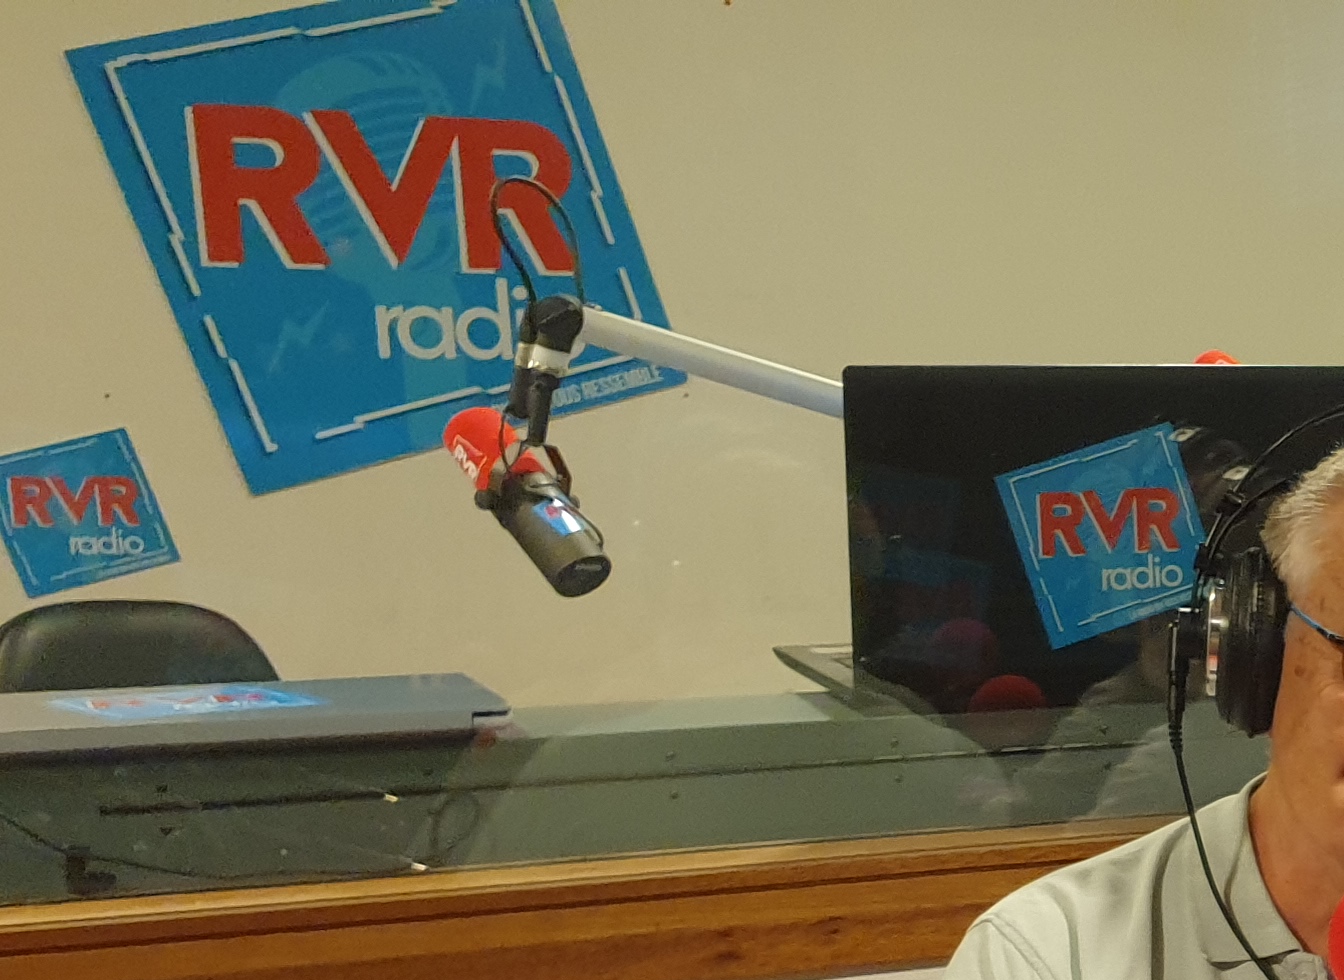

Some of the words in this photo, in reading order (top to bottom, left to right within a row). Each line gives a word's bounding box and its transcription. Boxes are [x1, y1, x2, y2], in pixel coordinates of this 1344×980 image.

[184, 103, 577, 275] RVR
[374, 277, 586, 361] radi
[7, 475, 141, 529] RVR
[1036, 487, 1182, 559] RVR
[69, 525, 145, 557] radio
[1101, 554, 1184, 591] radio
